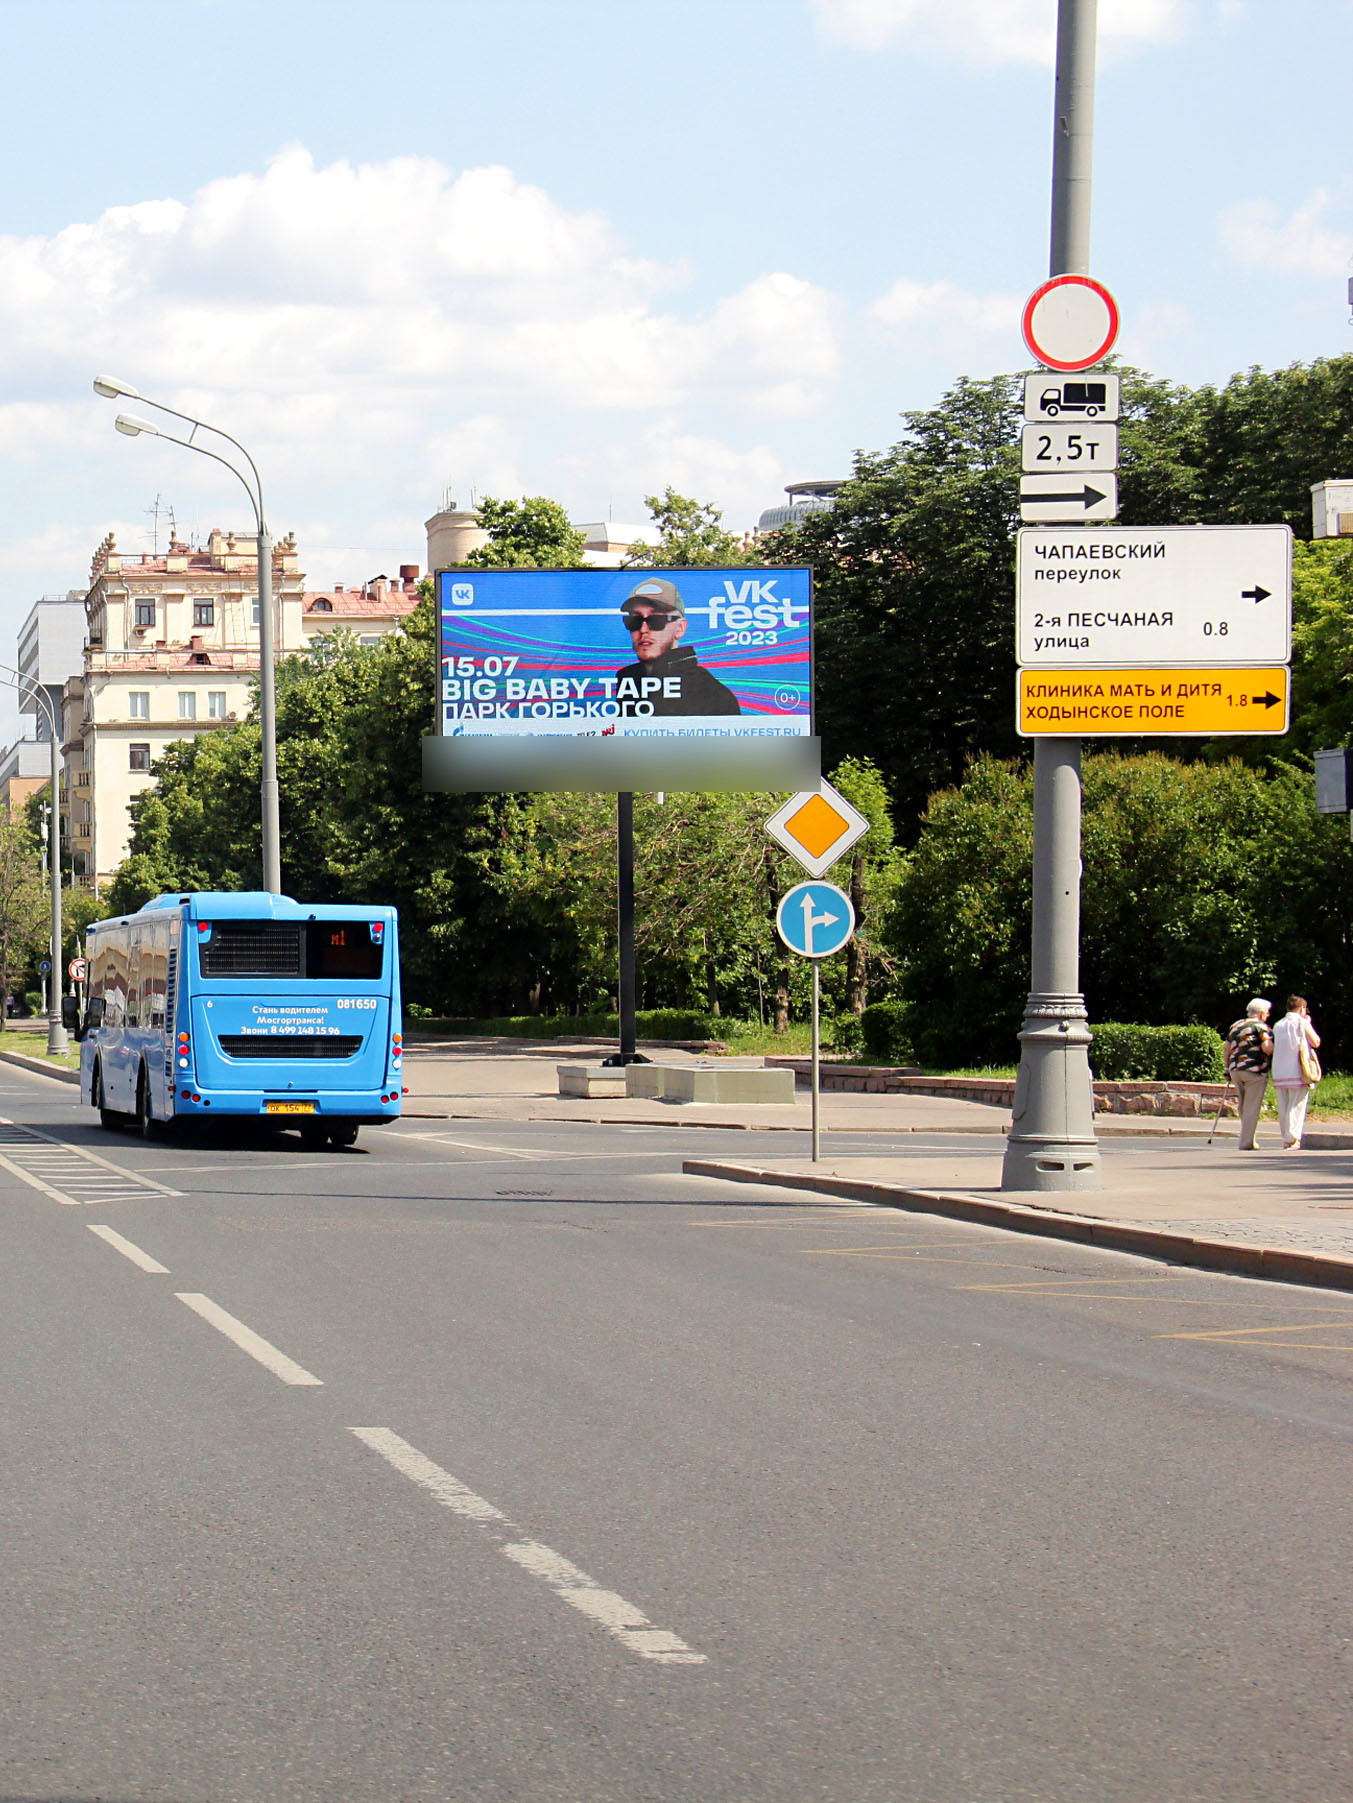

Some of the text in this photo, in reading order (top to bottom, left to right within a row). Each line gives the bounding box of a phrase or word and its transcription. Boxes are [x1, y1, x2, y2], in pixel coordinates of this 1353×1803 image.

[1036, 435, 1100, 464] 2,5т
[1034, 541, 1166, 560] ЧАПАЕВСКИЙ
[1034, 568, 1122, 584] переулок
[723, 580, 779, 604] VK
[708, 596, 801, 630] fest
[1034, 612, 1174, 628] 2-я ПЕСЧАНАЯ
[1203, 621, 1229, 636] 0.8
[725, 630, 779, 646] 2023
[1033, 636, 1090, 652] улица
[442, 656, 520, 678] 15.07
[442, 676, 682, 701] BIG BABY TAPE
[1026, 683, 1222, 699] КЛИНИКА МАТЬ И ДИТЯ
[780, 692, 796, 703] 0+
[1227, 694, 1248, 707] 1.8
[443, 700, 655, 720] ПАРК ГОРЬКОГО
[1026, 704, 1185, 721] ХОДЫНСКОЕ ПОЛЕ
[252, 1006, 329, 1015] Стань водителем
[336, 998, 377, 1009] 081650
[257, 1016, 324, 1026] Мосгортранса!
[240, 1026, 340, 1036] Звони 8 499 148 15 96
